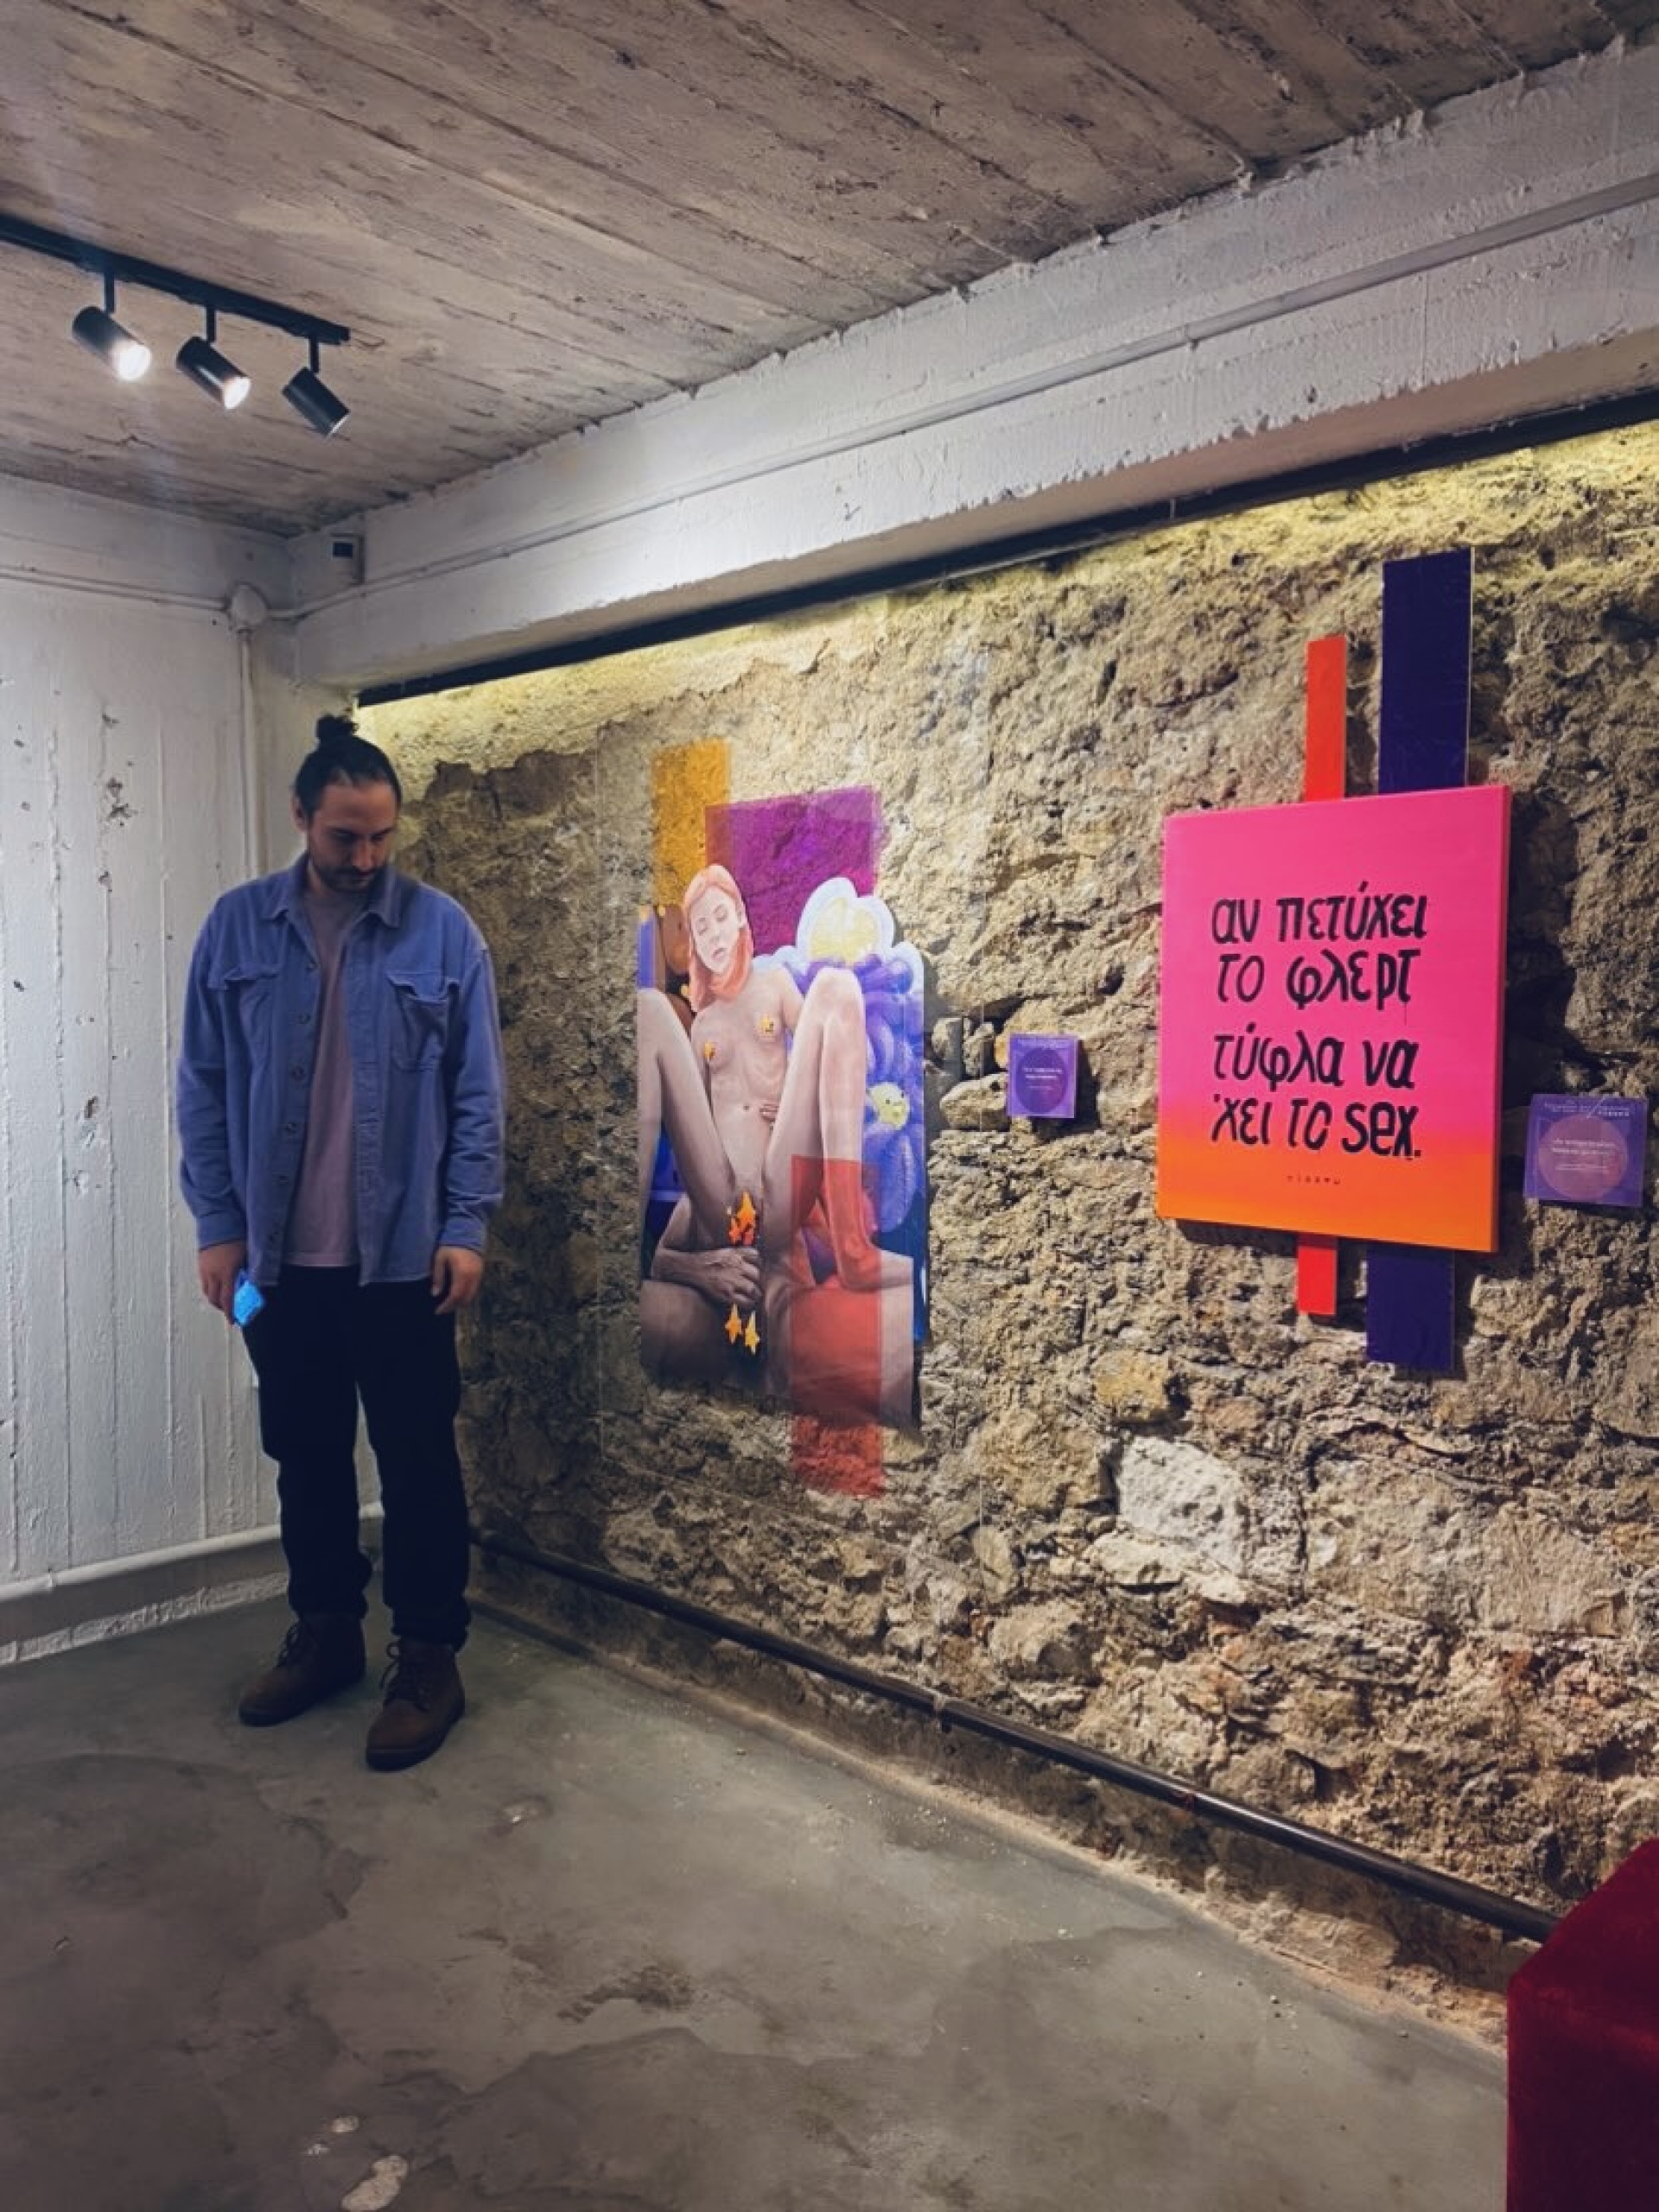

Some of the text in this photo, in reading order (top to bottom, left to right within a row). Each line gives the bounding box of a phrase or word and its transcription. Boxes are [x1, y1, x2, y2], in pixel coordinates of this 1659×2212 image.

[1211, 880, 1428, 944] αν πετύχει
[1217, 947, 1421, 1011] το φλερτ
[1213, 1022, 1420, 1092] τύφλα να
[1287, 1097, 1332, 1150] το
[1341, 1101, 1421, 1160] sex.
